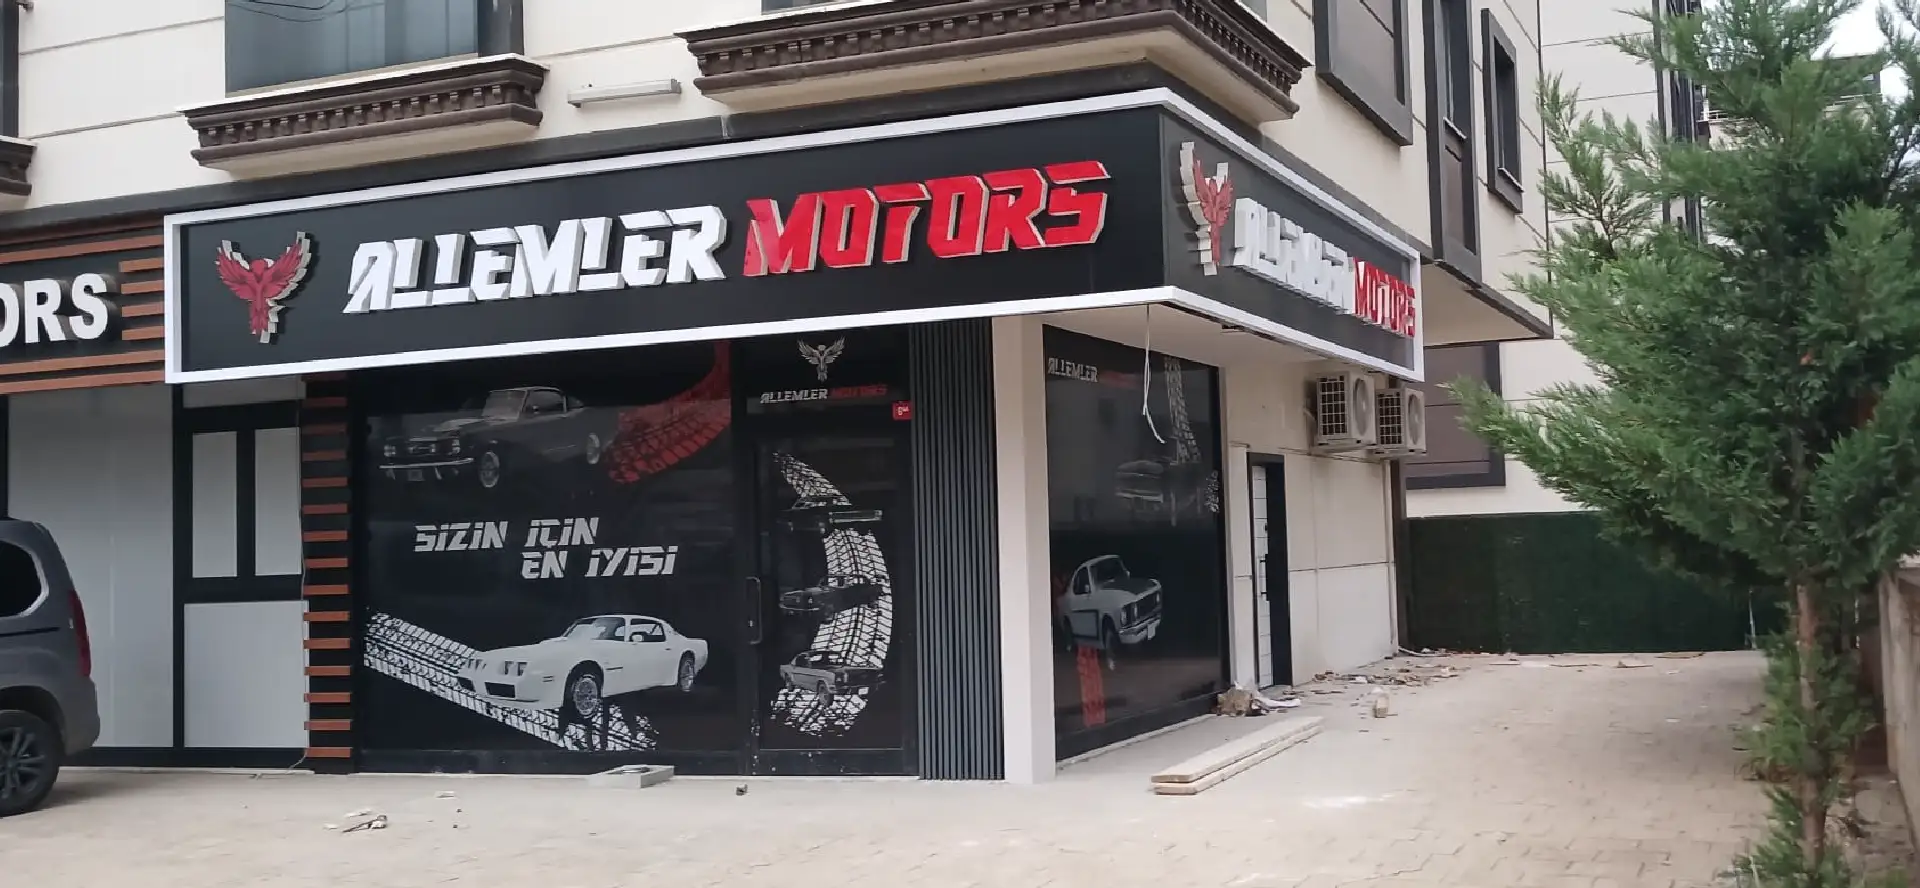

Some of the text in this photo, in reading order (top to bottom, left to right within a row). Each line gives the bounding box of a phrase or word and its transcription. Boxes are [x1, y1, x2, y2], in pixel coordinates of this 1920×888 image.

[342, 160, 1111, 313] ALLEMLER MOTORS
[760, 388, 829, 404] ALLEMLER
[520, 550, 568, 579] EN
